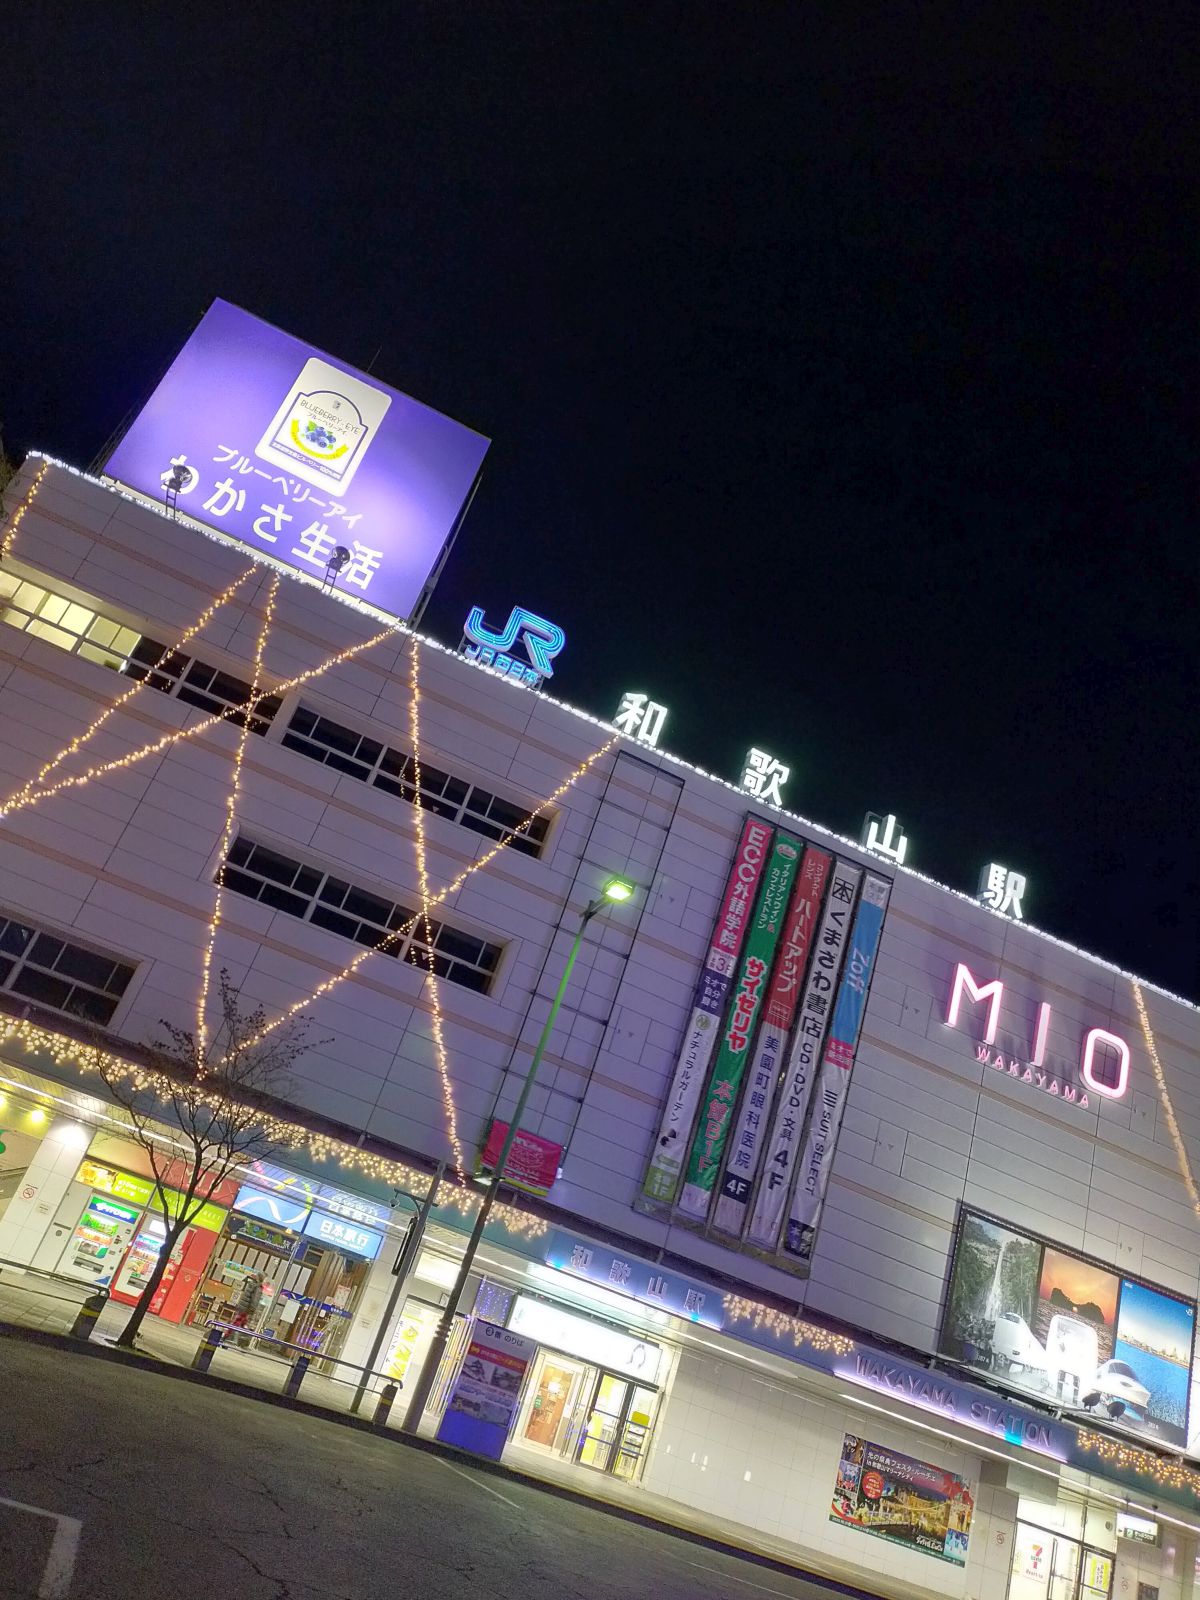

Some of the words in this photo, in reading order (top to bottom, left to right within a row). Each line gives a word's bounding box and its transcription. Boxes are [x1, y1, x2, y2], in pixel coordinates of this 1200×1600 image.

[300, 399, 342, 424] BLUEBERRY
[345, 422, 360, 434] EYE
[212, 444, 363, 529] ブルーベリーアイ
[160, 454, 384, 590] わかさ生活
[464, 605, 565, 679] JR
[464, 644, 540, 686] JR西日本
[614, 692, 1027, 918] 和歌山駅
[720, 825, 766, 949] ECC外語学院
[757, 868, 780, 930] カフェレストラン
[777, 898, 812, 992] ハートアップ
[846, 947, 871, 994] Zoff
[704, 987, 721, 999] 自分
[705, 975, 727, 991] ミオで
[726, 956, 767, 1053] サイゼリヤ
[944, 963, 1130, 1099] MIO
[669, 1031, 703, 1123] ナチュラルガーデン
[976, 1046, 1089, 1109] WAKAYAMA
[817, 1110, 831, 1141] SUIT
[726, 1179, 746, 1196] 4F
[768, 1150, 788, 1190] 4F
[804, 1142, 825, 1196] SELECT
[320, 1219, 370, 1247] 日本旅行
[570, 1244, 706, 1313] 和歌山駅
[504, 1334, 525, 1347] のりば
[856, 1352, 957, 1412] WAKAYAMA
[970, 1401, 1051, 1447] STATION
